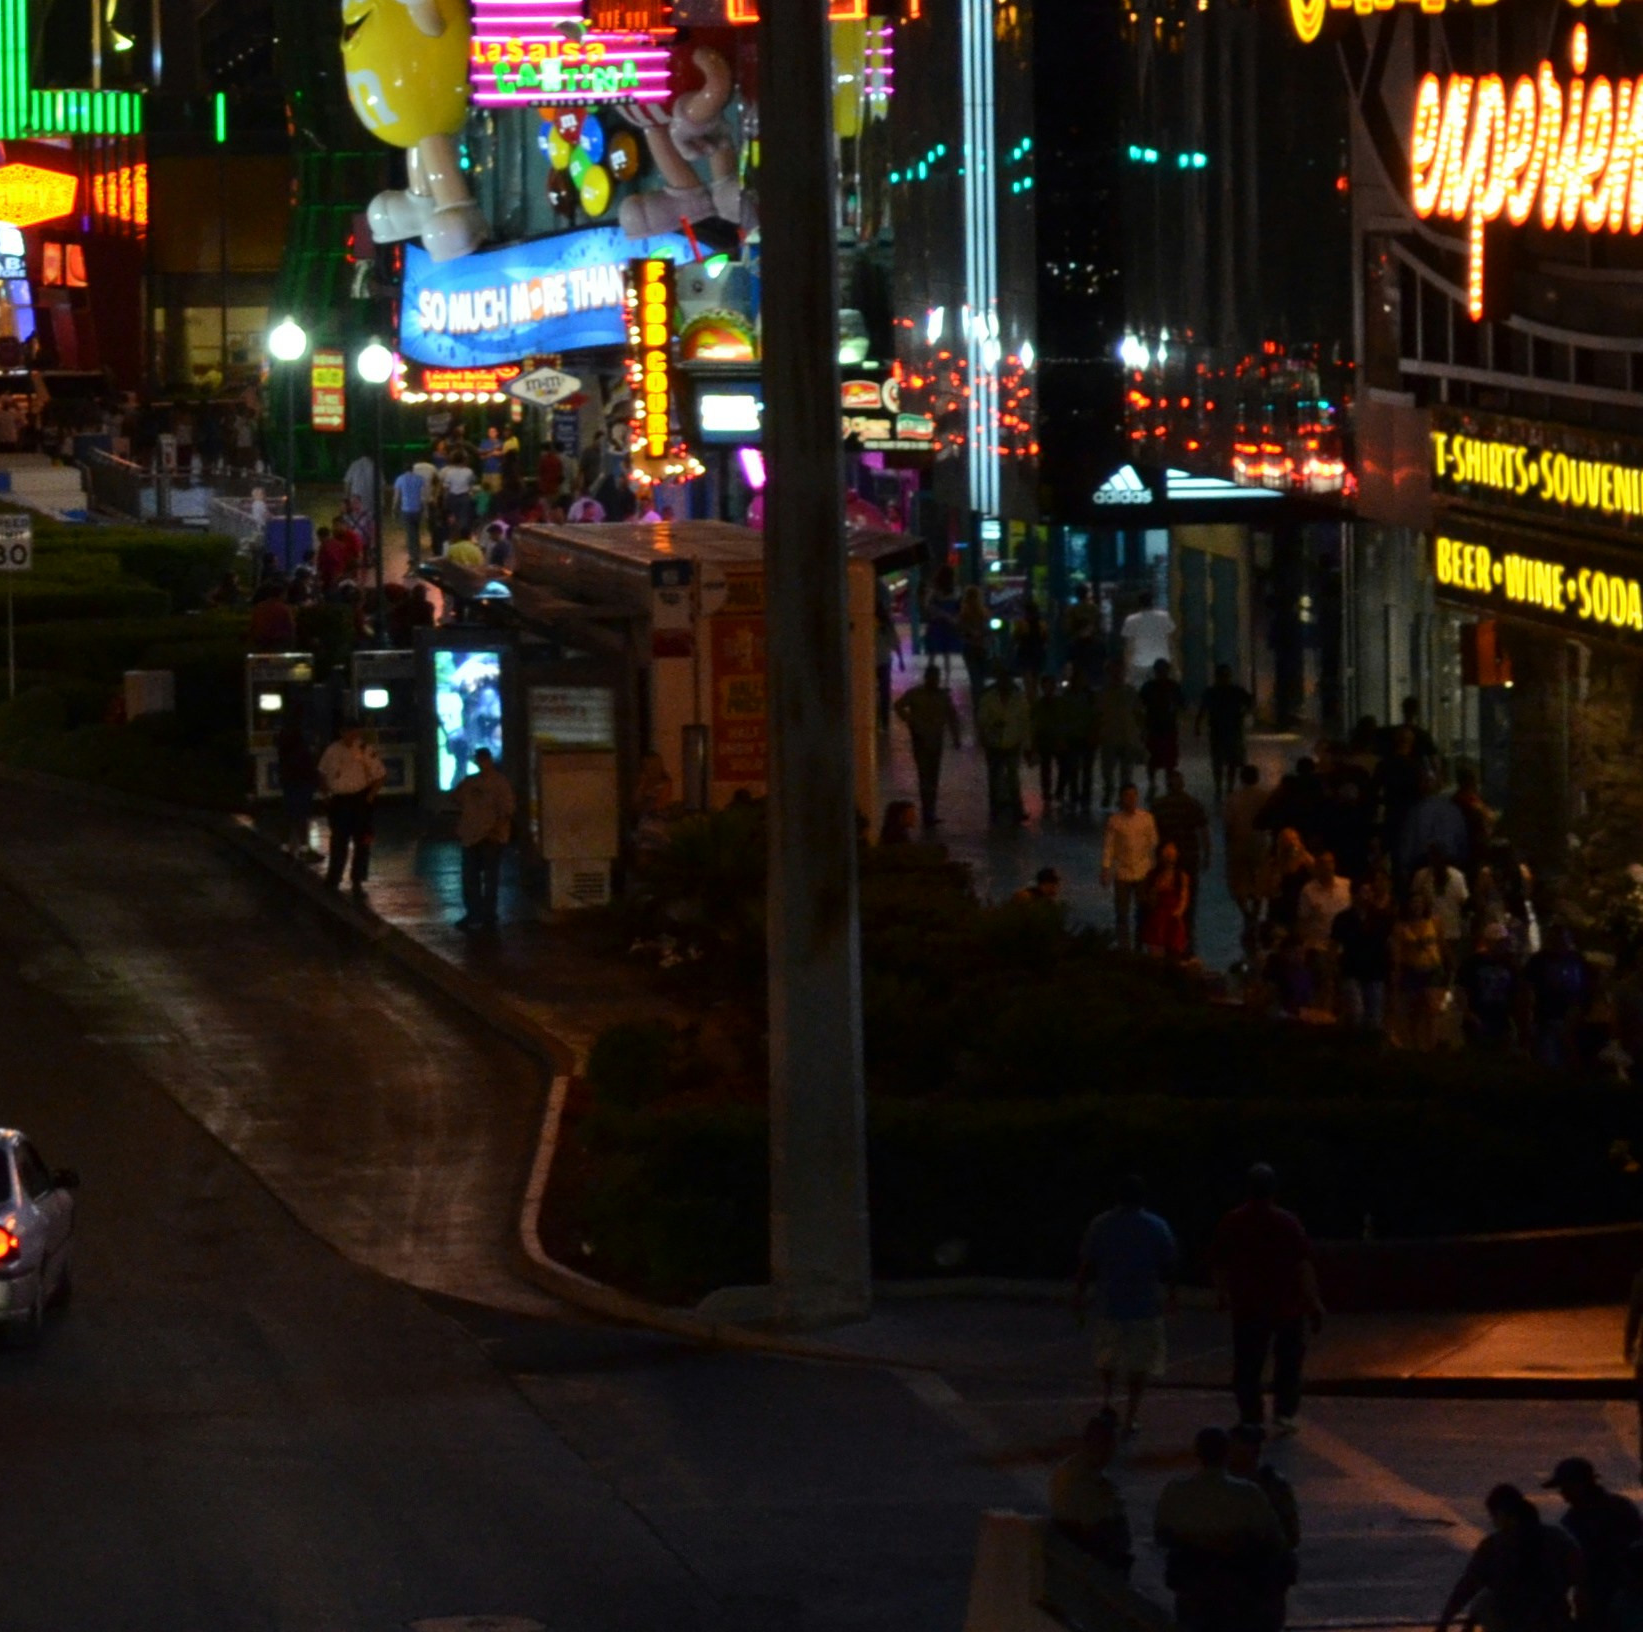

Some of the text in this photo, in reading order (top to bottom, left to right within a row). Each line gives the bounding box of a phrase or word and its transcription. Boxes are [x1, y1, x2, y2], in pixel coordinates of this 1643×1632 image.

[418, 264, 627, 335] SO MUCH MORE THAN
[644, 260, 669, 457] FOOD COURT
[1092, 487, 1153, 505] adidas
[1430, 430, 1530, 496] T-SHIRTS
[1436, 536, 1643, 632] BEER WINE SODA
